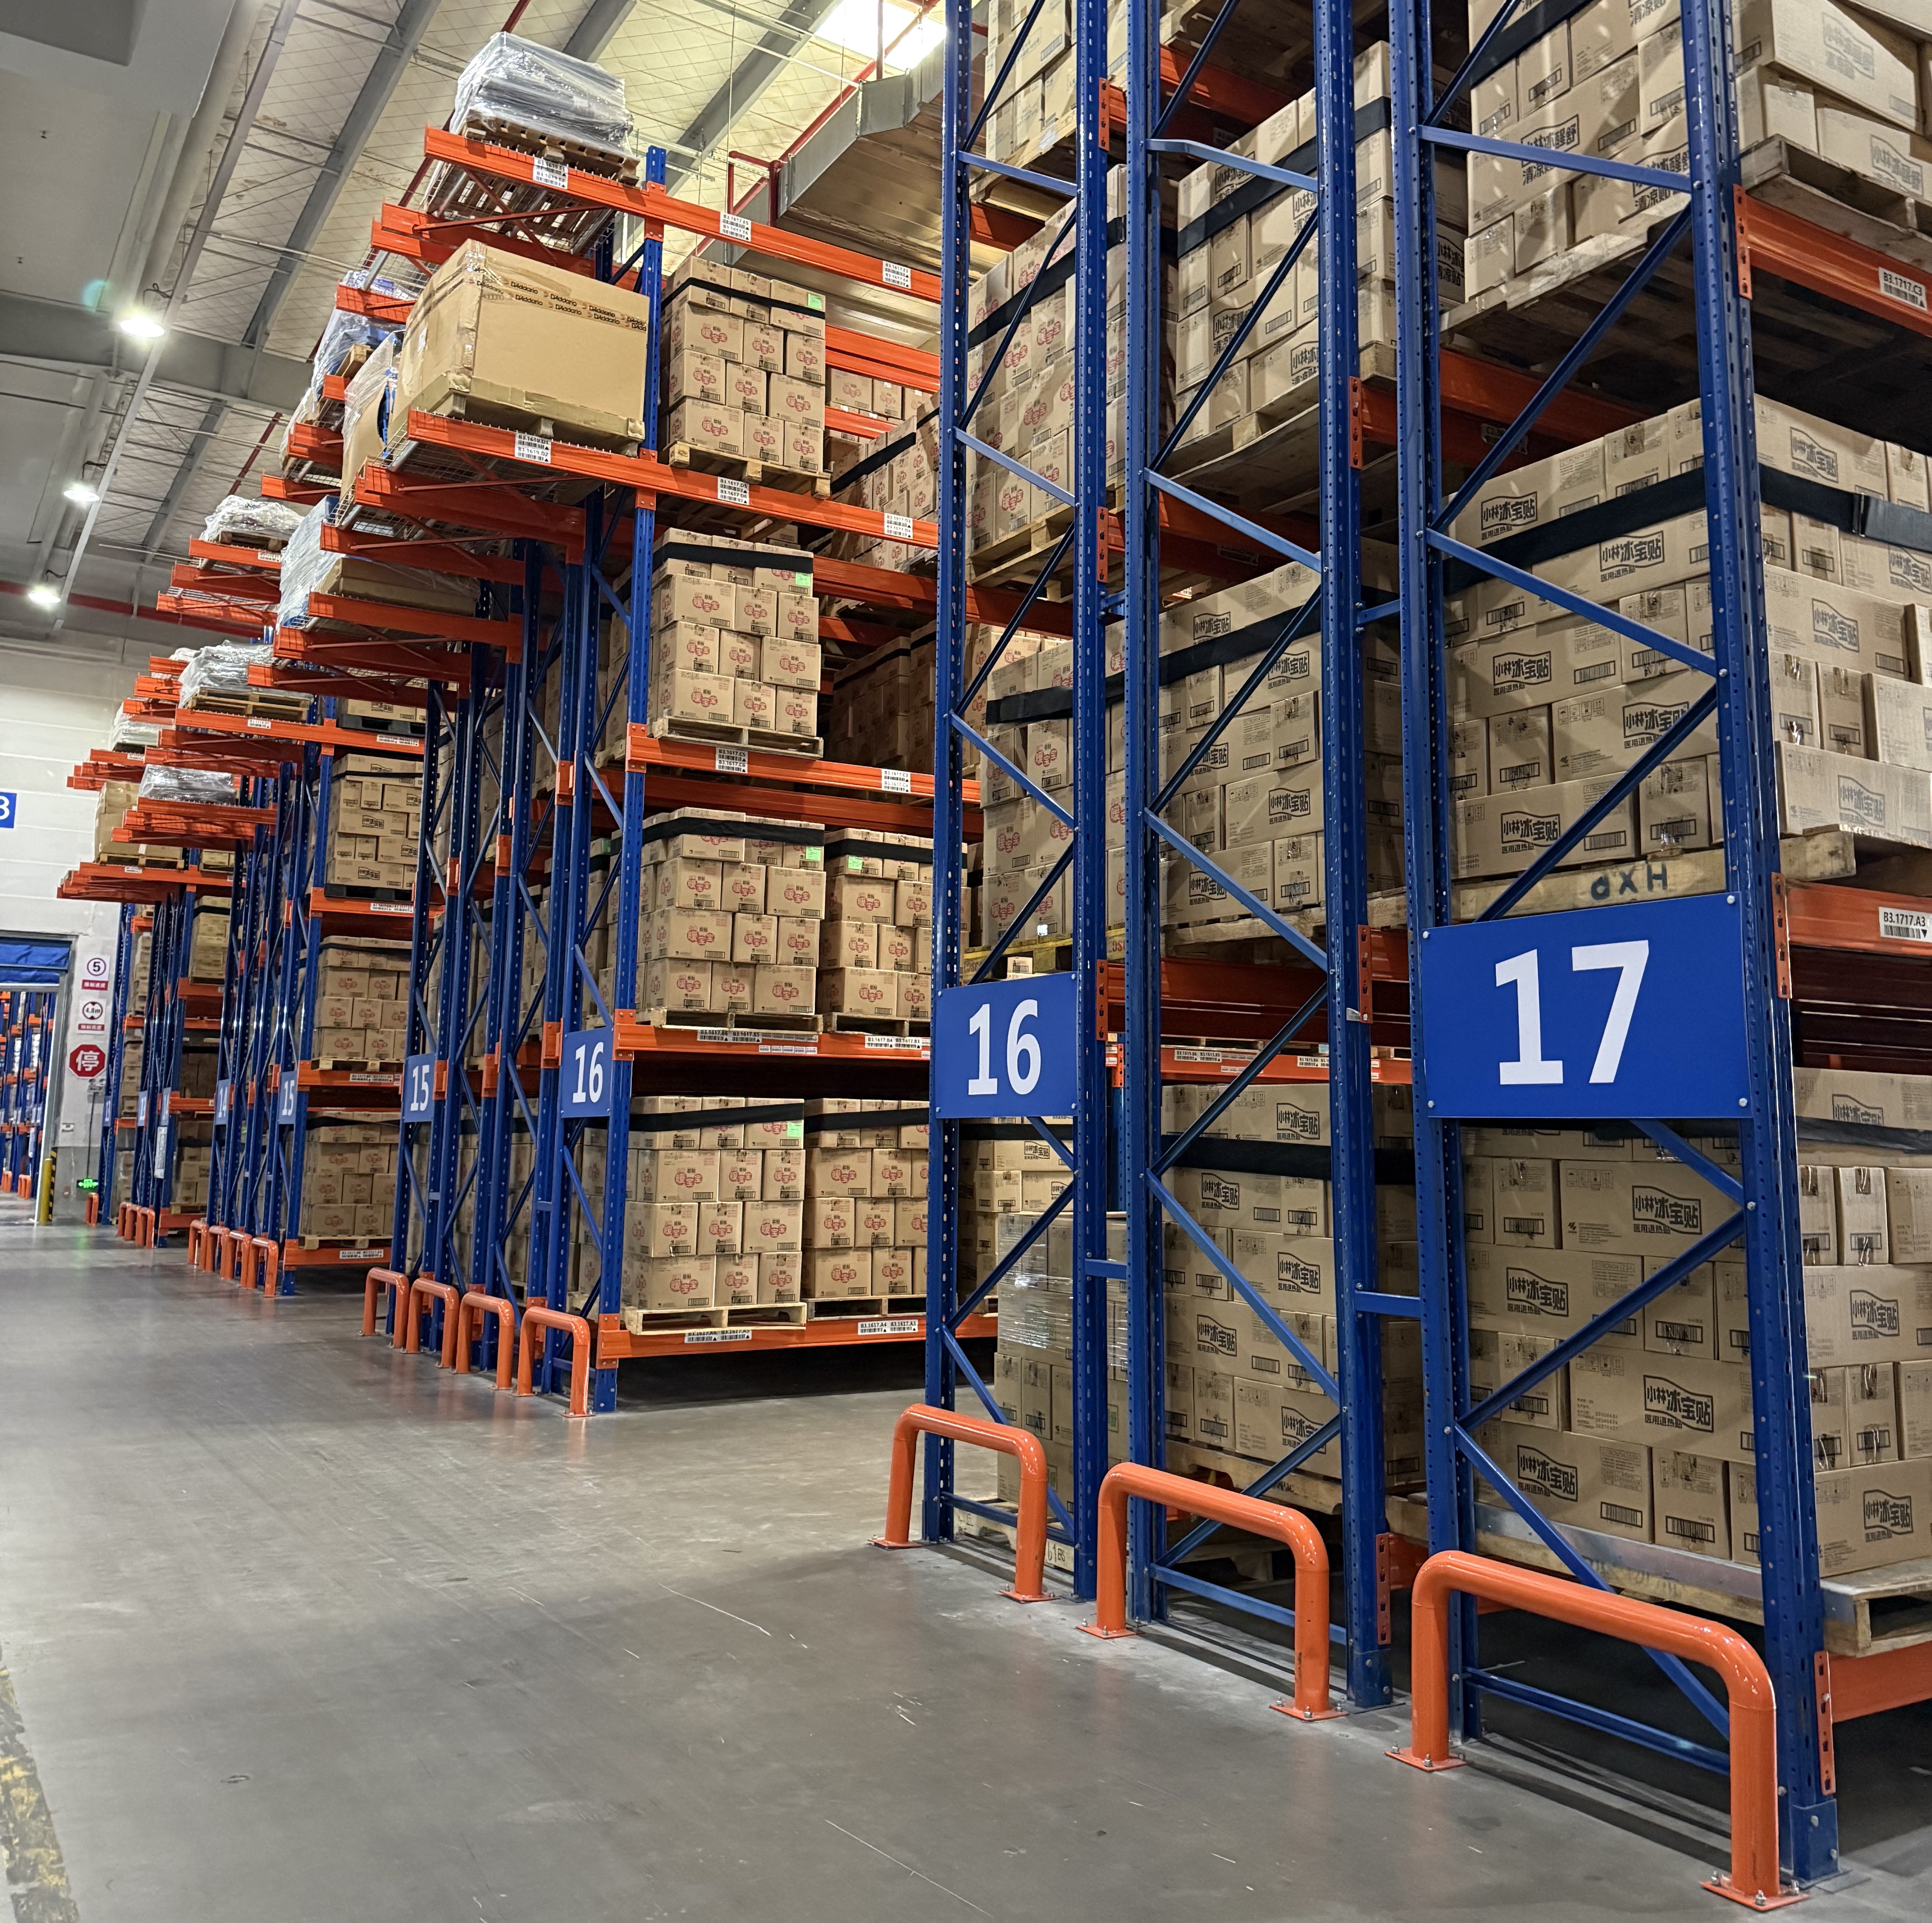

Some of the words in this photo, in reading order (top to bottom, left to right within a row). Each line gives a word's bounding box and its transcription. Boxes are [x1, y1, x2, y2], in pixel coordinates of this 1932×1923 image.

[511, 281, 538, 294] D'Addario
[1884, 271, 1922, 296] B3.1717.C3
[515, 295, 542, 306] D'Addario
[551, 294, 577, 306] D'Addario
[556, 304, 581, 315] D'Addario
[589, 305, 615, 317] D'Addario
[594, 313, 620, 325] D'Addario
[518, 446, 548, 457] B3.1619.D2
[721, 479, 747, 488] B3.1617.D5
[721, 489, 747, 499] B3.1617.D6
[1483, 499, 1536, 522] 小林冰宝贴
[1602, 537, 1662, 562] 小林冰宝贴
[1195, 616, 1229, 635] 小林冰宝贴
[1495, 657, 1551, 680] 小林冰宝贴
[1493, 683, 1525, 696] 医用退热贴
[719, 749, 745, 758] B3.1617.C5
[1035, 749, 1058, 767] 暖宝宝
[1270, 794, 1309, 813] 小林冰宝贴
[1503, 818, 1559, 841] 小林冰宝贴
[997, 832, 1020, 853] 暖宝宝
[1502, 844, 1534, 854] 医用退热贴
[687, 879, 711, 892] 暖宝宝
[732, 882, 755, 896] 暖宝宝
[784, 888, 810, 903] 暖宝宝
[990, 902, 1015, 920] 暖宝宝
[1884, 911, 1926, 927] B3.1717.A3
[687, 930, 715, 945] 暖宝宝
[745, 933, 767, 947] 暖宝宝
[788, 937, 810, 950] 暖宝宝
[93, 962, 100, 972] 5
[677, 978, 701, 992] 暖宝宝
[722, 980, 745, 994] 暖宝宝
[773, 985, 799, 1000] 暖宝宝
[1495, 940, 1649, 1084] 17
[968, 999, 1041, 1095] 16
[76, 1050, 100, 1071] 停
[573, 1042, 603, 1103] 16
[410, 1065, 429, 1112] 15
[218, 1087, 227, 1117] 14
[282, 1080, 295, 1117] 15
[1278, 1110, 1318, 1134] 小林冰宝贴
[1203, 1180, 1239, 1206] 小林冰宝贴
[1635, 1194, 1699, 1229] 小林冰宝贴
[1633, 1224, 1672, 1235] 医用退热贴
[1279, 1259, 1319, 1289] 小林冰宝贴
[1509, 1277, 1566, 1310] 小林冰宝贴
[1852, 1300, 1898, 1330] 小林冰宝贴
[1199, 1322, 1235, 1352] 小林冰宝贴
[1646, 1385, 1711, 1426] 小林冰宝贴
[1645, 1414, 1683, 1429] 医用退热贴
[1519, 1455, 1575, 1495] 小林冰宝贴
[1518, 1481, 1551, 1497] 医用退热贴
[1865, 1501, 1911, 1528] 小林冰宝贴
